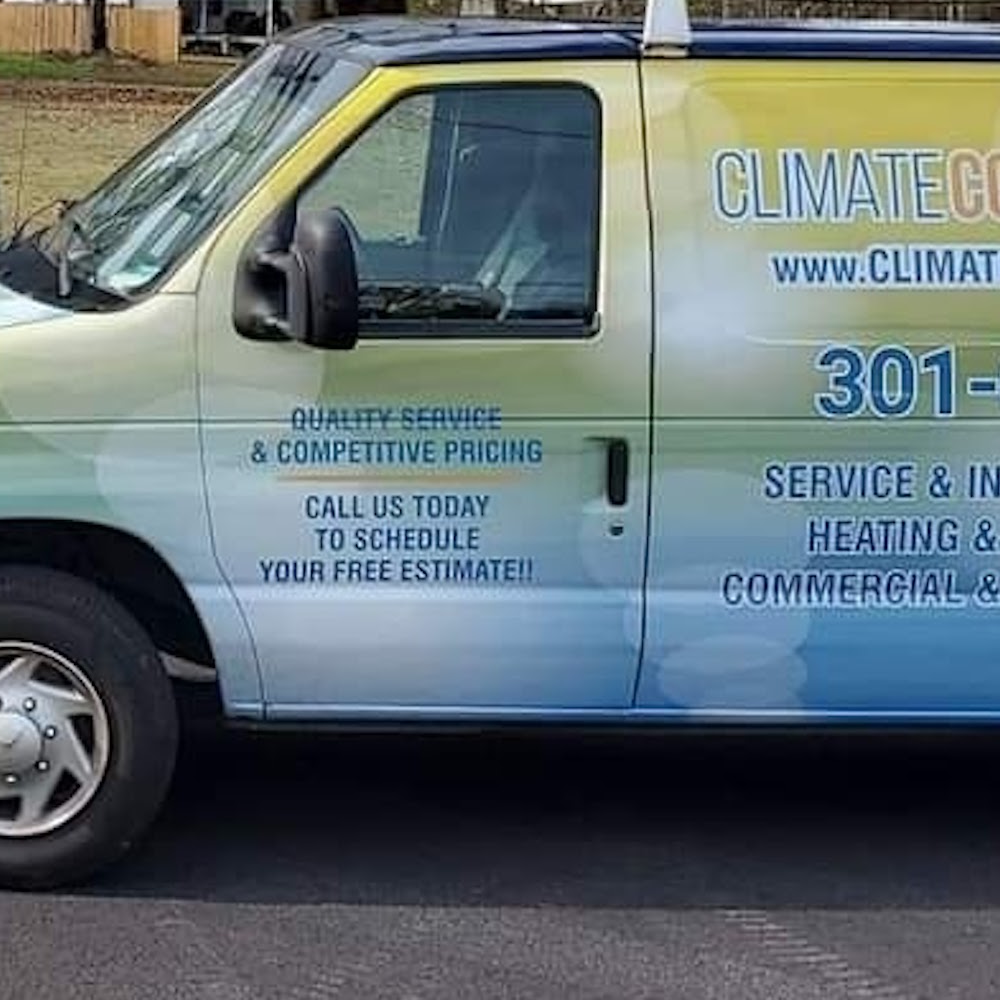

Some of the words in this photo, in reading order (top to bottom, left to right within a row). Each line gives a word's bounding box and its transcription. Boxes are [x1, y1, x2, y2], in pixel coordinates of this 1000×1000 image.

[771, 248, 999, 284] www.CLIMAT
[291, 407, 393, 431] QUALITY
[402, 407, 502, 430] SERVICE
[251, 441, 268, 463] &
[277, 440, 433, 464] COMPETITIVE
[445, 440, 543, 463] PRICING
[765, 464, 914, 499] SERVICE
[929, 464, 952, 498] &
[969, 464, 1000, 498] IN
[305, 495, 364, 519] CALL
[372, 495, 403, 519] US
[412, 495, 490, 519] TODAY
[315, 528, 344, 551] TO
[354, 528, 480, 551] SCHEDULE
[808, 518, 959, 552] HEATING
[974, 519, 997, 552] &
[260, 560, 324, 584] YOUR
[334, 559, 393, 583] FREE
[402, 559, 533, 583] ESTIMATE!!
[722, 572, 962, 605] COMMERCIAL
[977, 572, 1000, 604] &
